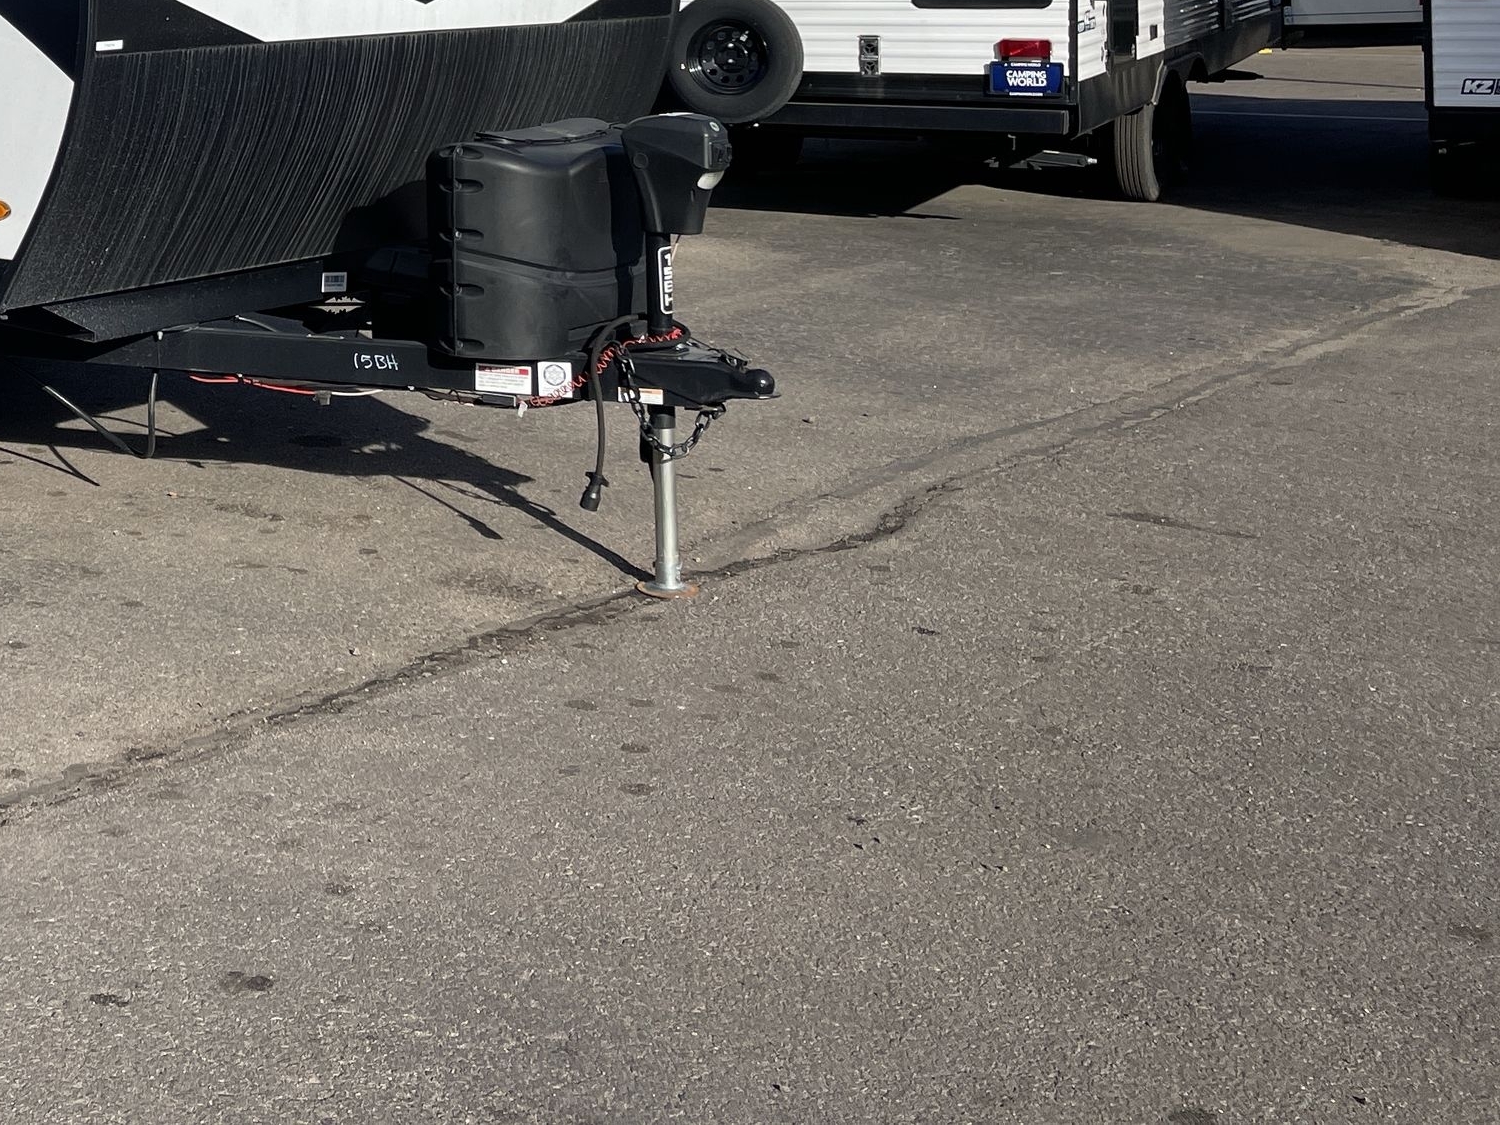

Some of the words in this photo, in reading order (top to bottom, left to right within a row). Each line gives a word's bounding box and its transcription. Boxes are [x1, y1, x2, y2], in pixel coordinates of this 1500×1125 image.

[1006, 70, 1047, 79] CAMPING
[1007, 77, 1047, 87] WORLD
[1463, 80, 1494, 93] KZ
[354, 352, 399, 371] 15BH
